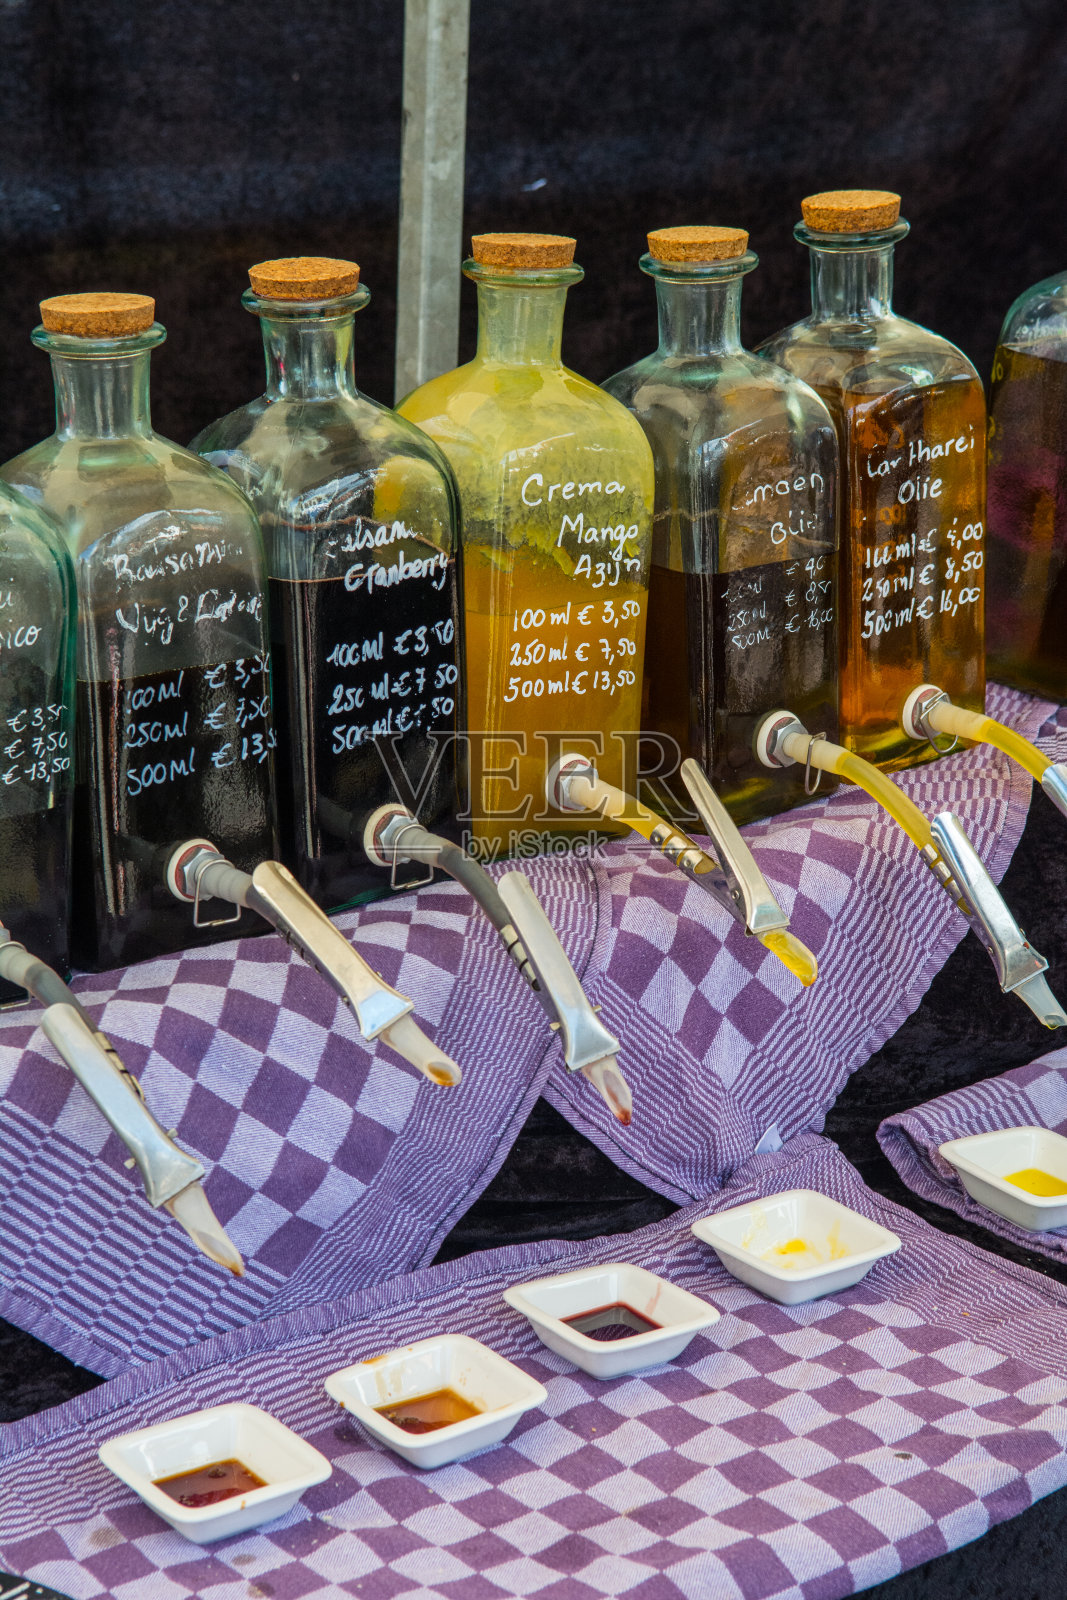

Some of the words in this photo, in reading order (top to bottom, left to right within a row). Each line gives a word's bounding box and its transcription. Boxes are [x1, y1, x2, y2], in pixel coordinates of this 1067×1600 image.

[521, 473, 625, 507] Crema
[898, 476, 943, 504] Olie
[557, 512, 639, 562] Mango
[344, 550, 448, 594] Cranberry
[574, 551, 641, 588] Azijn
[945, 551, 984, 583] 8,50
[577, 605, 595, 626] €
[602, 600, 641, 629] 3,50
[939, 587, 980, 616] 16,00
[574, 642, 590, 662] €
[598, 637, 636, 665] 7,50
[593, 669, 636, 696] 13,50
[32, 731, 68, 758] 7,50
[24, 757, 70, 782] 13,50
